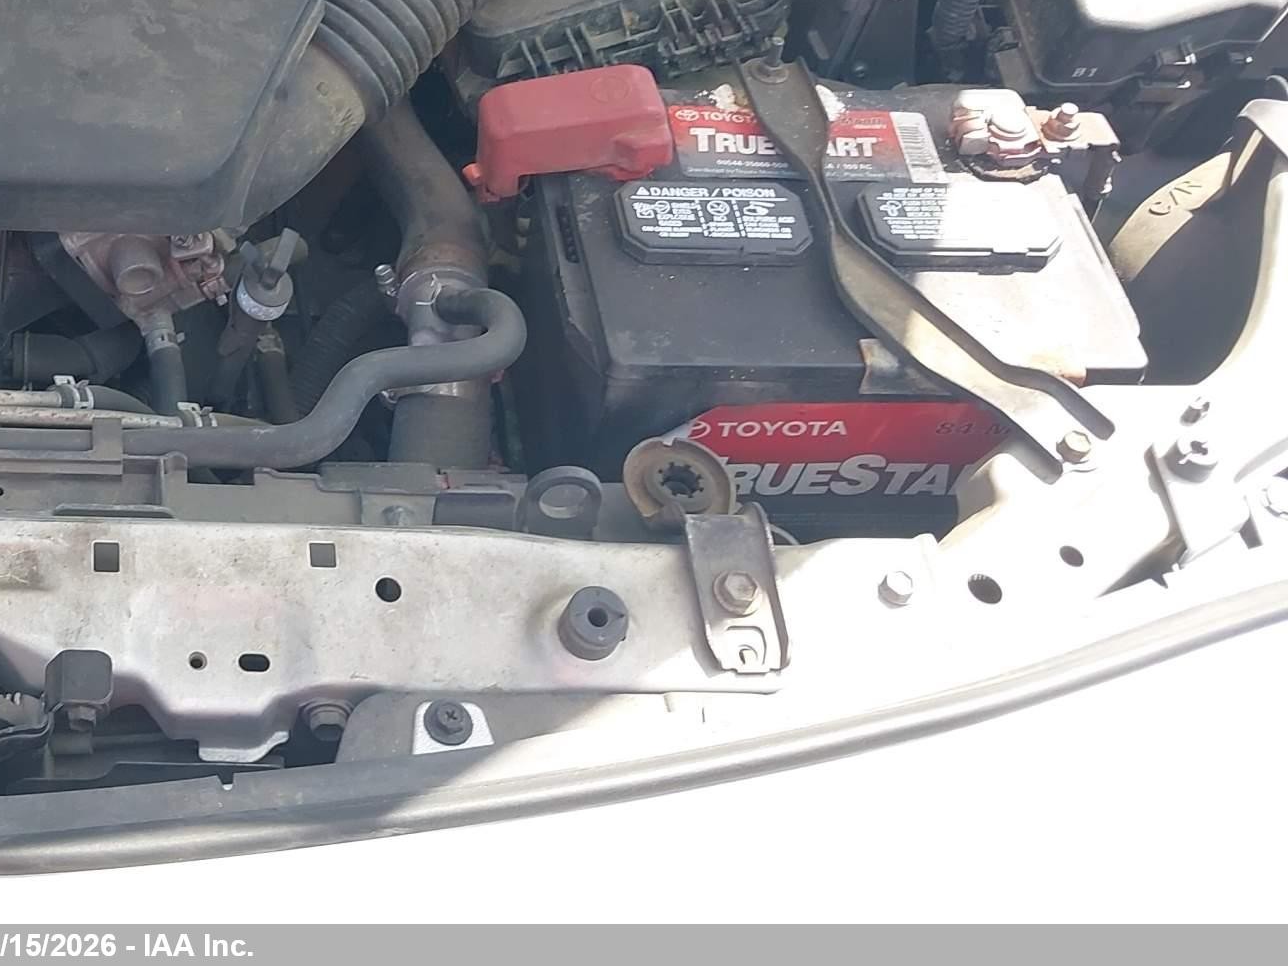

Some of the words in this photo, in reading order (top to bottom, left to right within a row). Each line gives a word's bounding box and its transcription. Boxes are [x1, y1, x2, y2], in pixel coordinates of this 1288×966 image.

[703, 110, 757, 124] TOYOT
[650, 187, 709, 198] DANGER
[723, 188, 776, 198] POISON
[717, 421, 847, 437] TOYOTA
